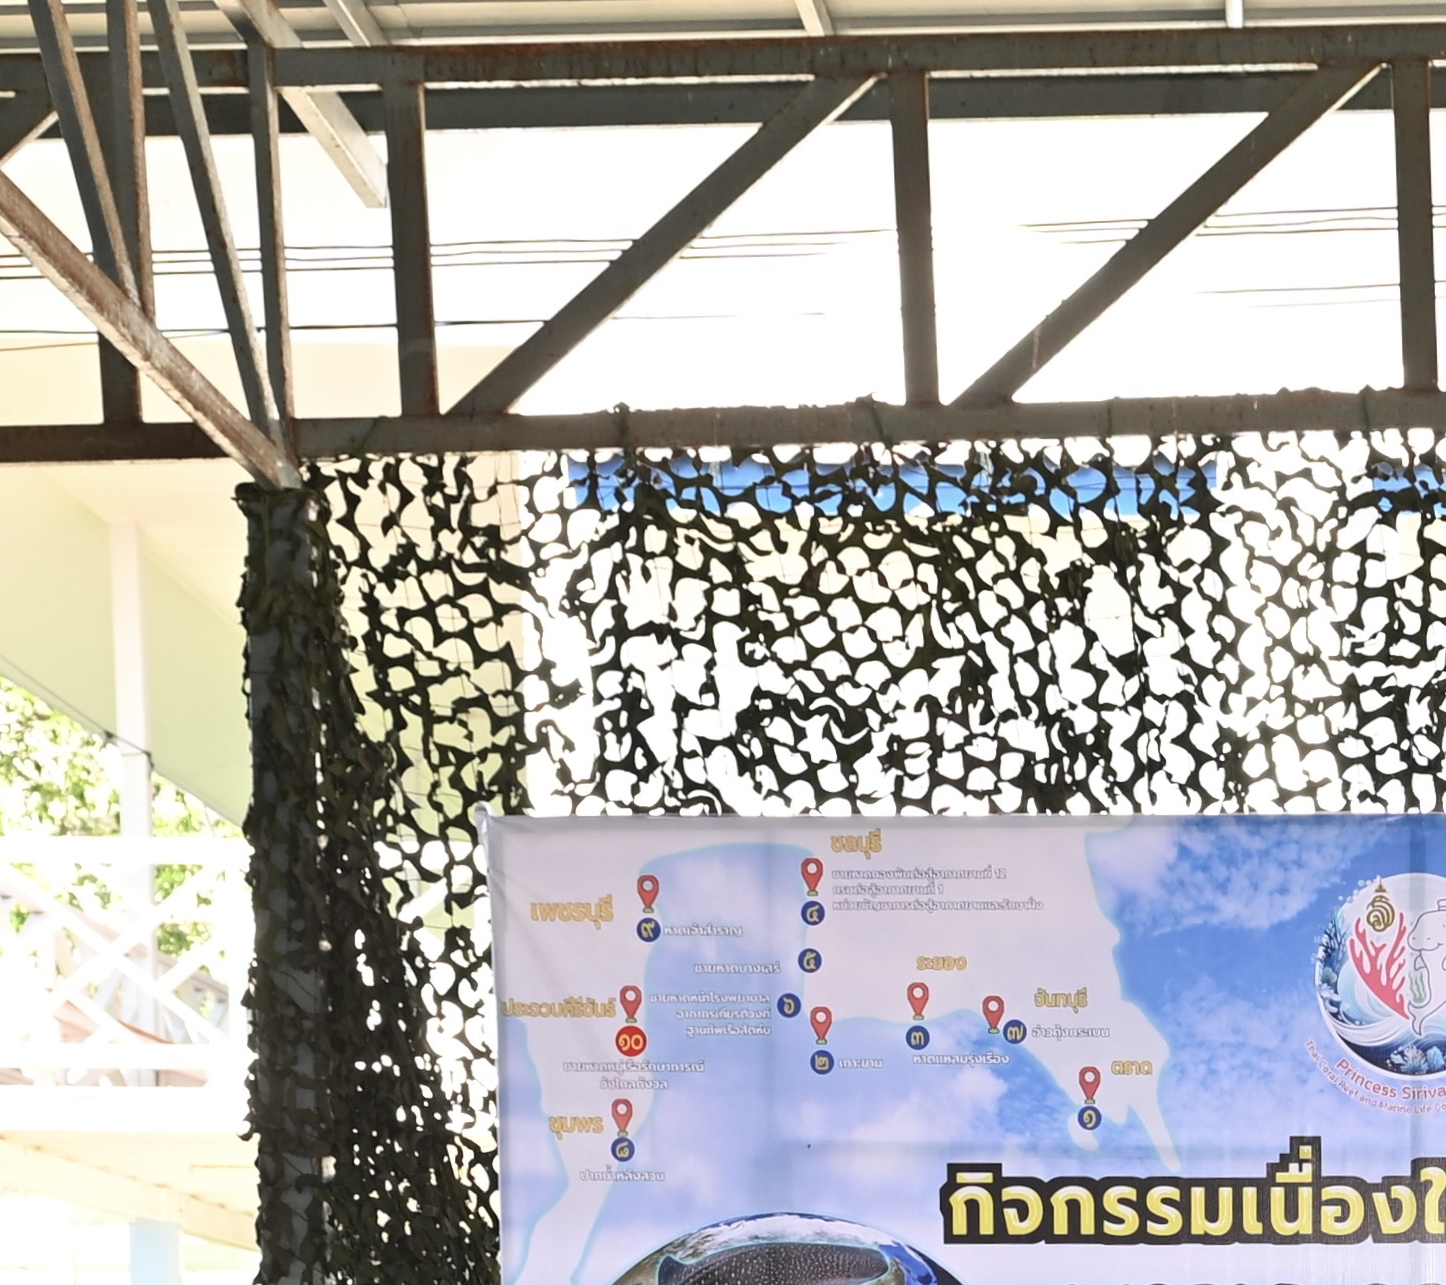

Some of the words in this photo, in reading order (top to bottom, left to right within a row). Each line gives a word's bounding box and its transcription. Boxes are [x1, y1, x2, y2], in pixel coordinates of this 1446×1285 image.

[830, 828, 882, 859] ชลบุรี
[530, 895, 614, 930] เพชรบุรี
[916, 955, 967, 971] ระยอง
[1034, 987, 1088, 1013] จันทบุรี
[618, 1033, 644, 1050] ๑๐
[1110, 1060, 1153, 1076] ตราด
[1336, 1057, 1397, 1099] Princess
[1414, 1103, 1432, 1114] Life
[549, 1115, 604, 1140] ชุมพร
